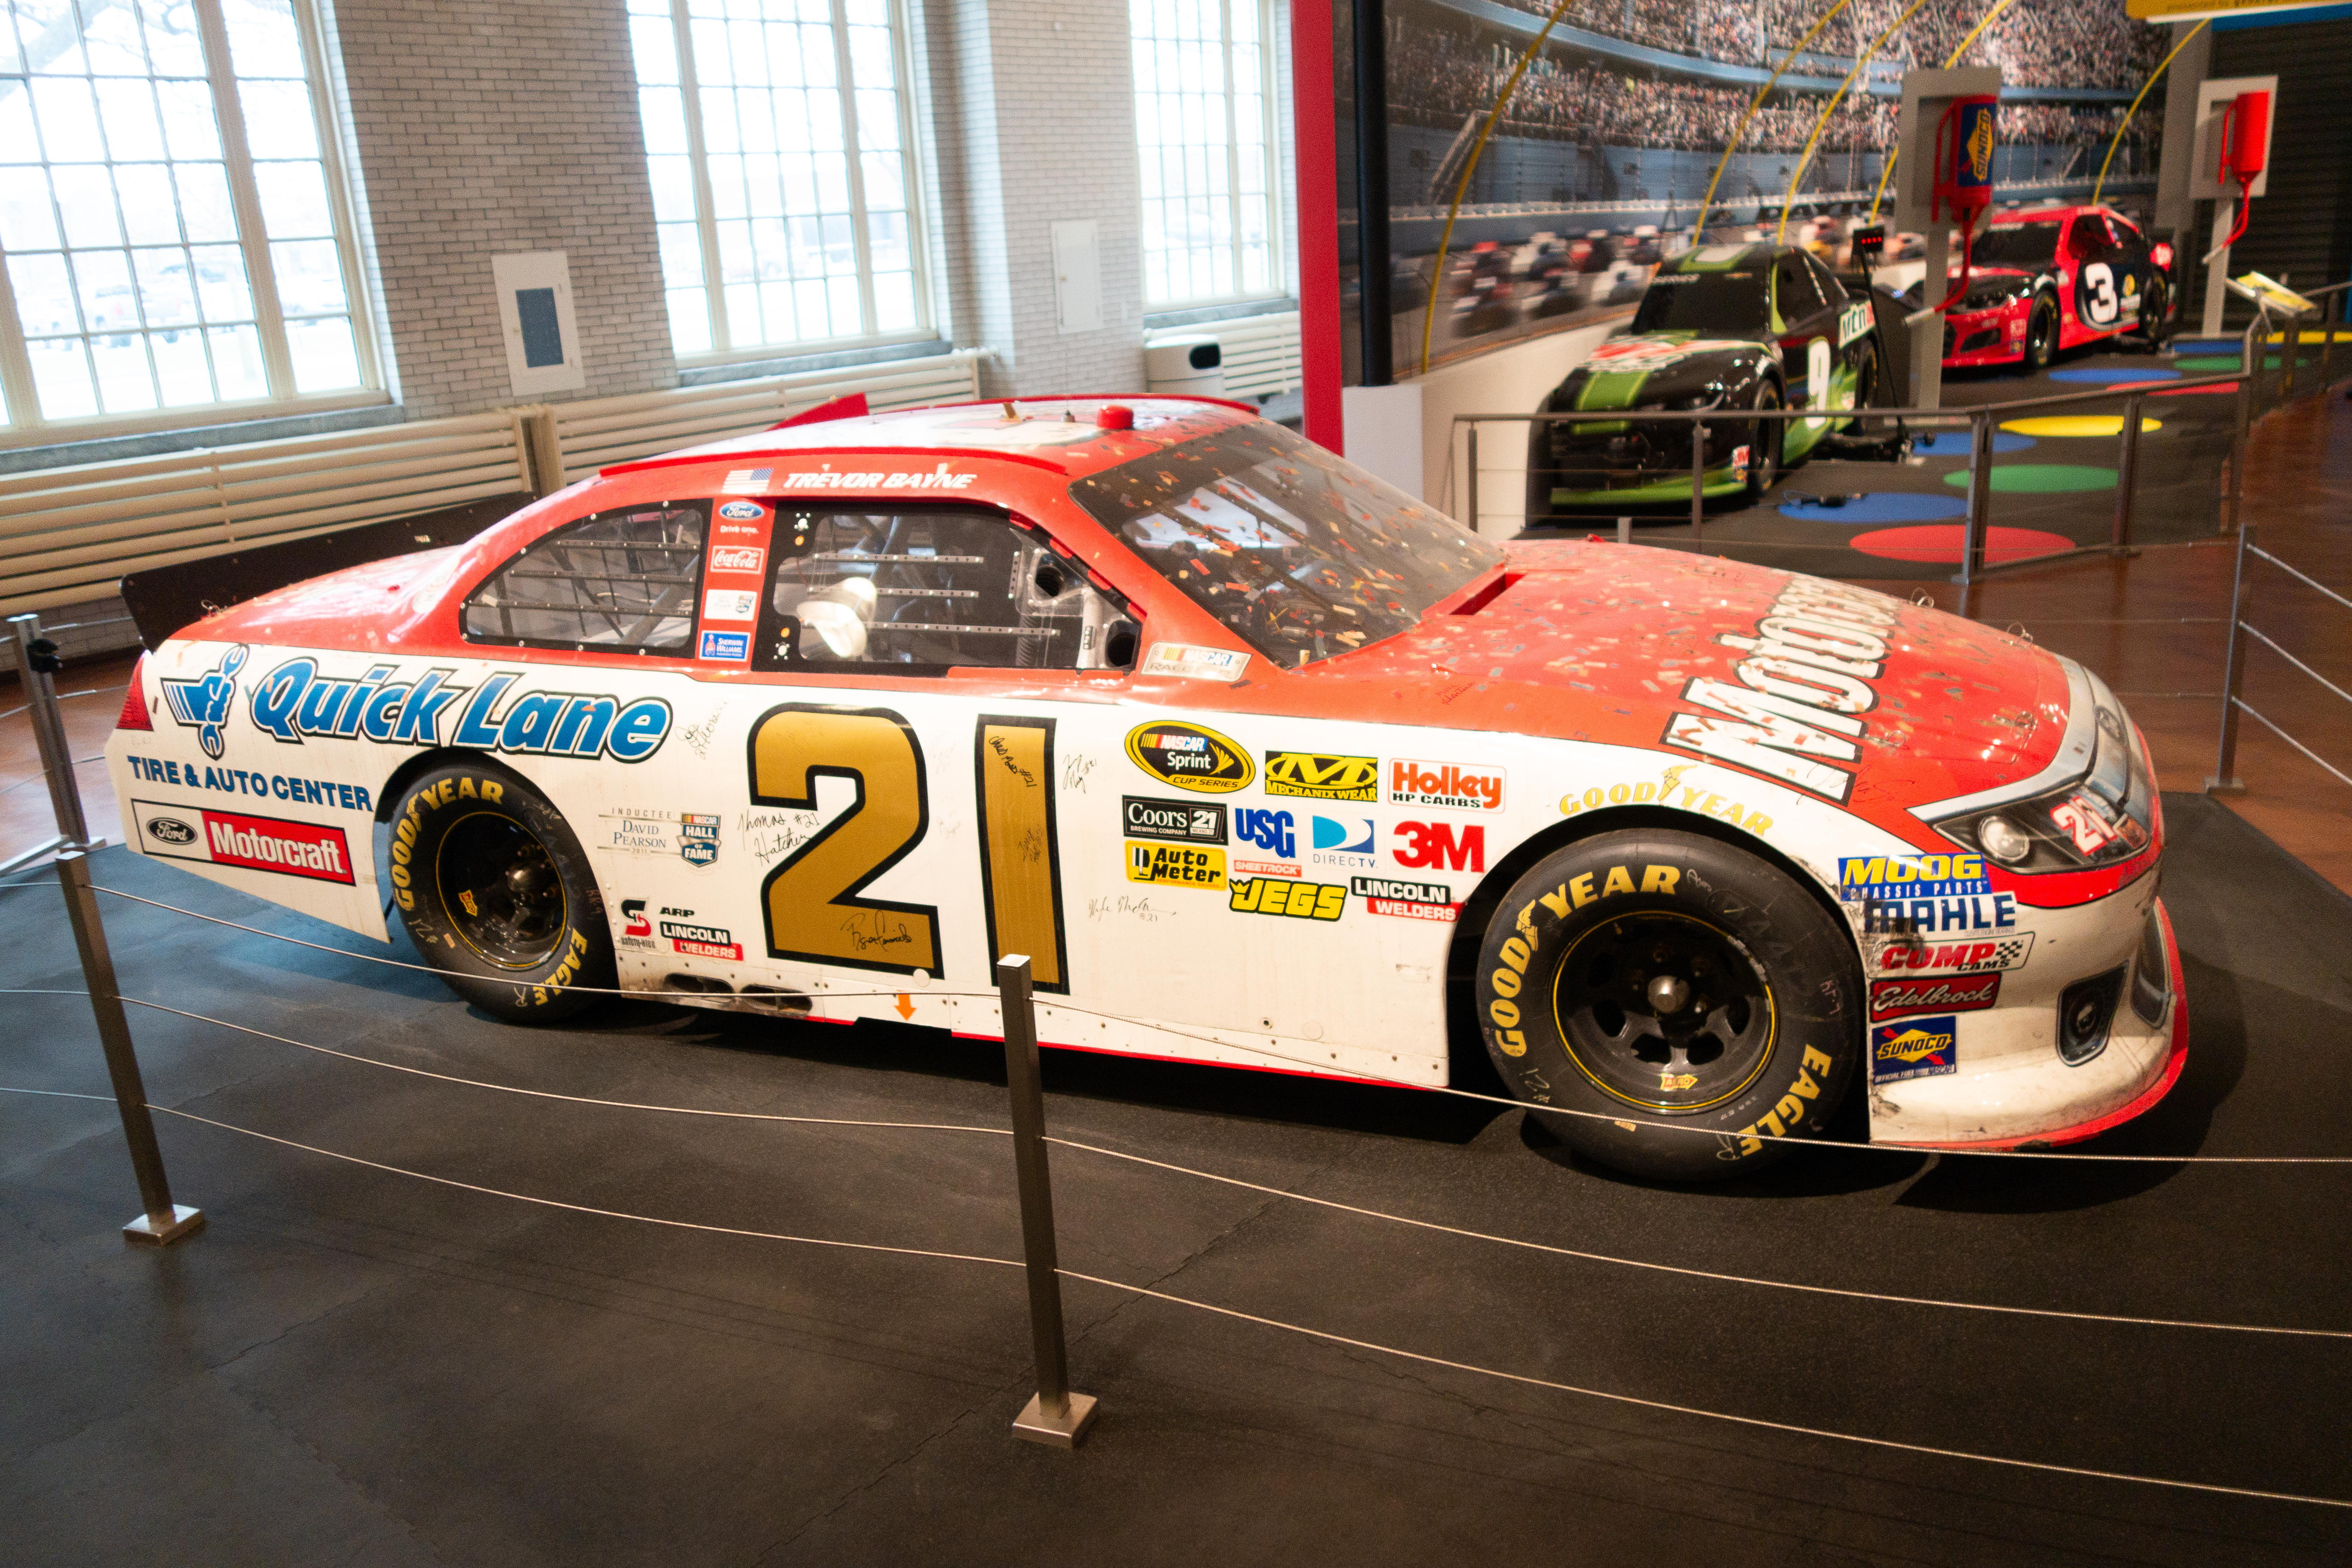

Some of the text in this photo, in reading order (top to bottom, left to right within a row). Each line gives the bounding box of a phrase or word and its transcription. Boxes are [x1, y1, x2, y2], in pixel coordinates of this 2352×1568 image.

[2085, 262, 2117, 322] 3
[1806, 339, 1830, 429] 9
[784, 473, 977, 489] TREVOR BAYNE
[1149, 662, 1192, 673] RACE
[1182, 649, 1229, 666] NASCAR
[1659, 574, 1902, 807] Motorc
[250, 656, 466, 747] Quick
[453, 670, 673, 764] Lane
[1161, 735, 1206, 751] NASCAR
[1167, 751, 1211, 770] Sprint
[127, 755, 374, 812] TIRE & AUTO CENTER
[1198, 779, 1239, 788] SERIES
[1266, 780, 1377, 802] MECHANIX WEAR
[1393, 762, 1502, 809] Holley
[1393, 793, 1481, 808] HP CARBS
[612, 807, 671, 819] INDUCTEE
[1128, 803, 1217, 829] Coors 21
[686, 826, 714, 838] HALL
[1130, 825, 1157, 833] BREWING
[1235, 808, 1296, 858] USG
[2050, 795, 2116, 857] 21
[209, 821, 345, 874] Motorcraft
[685, 848, 714, 860] FAME
[747, 701, 1070, 995] 21
[1154, 848, 1208, 866] Auto
[1393, 821, 1485, 873] 3M
[1235, 861, 1298, 875] SHEETROCK
[1313, 854, 1375, 868] DIRECTV
[1843, 854, 1981, 885] MOOG
[1150, 863, 1221, 882] Meter
[1230, 877, 1348, 922] JEGS
[1355, 879, 1447, 903] LINCOLN
[1850, 881, 1983, 900] CHASSIS PARTS
[659, 906, 695, 917] ARP
[1375, 900, 1457, 921] WELDERS
[662, 924, 728, 945] LINCOLN
[680, 941, 737, 959] WELDERS
[1880, 943, 1996, 970] COMP
[533, 928, 588, 1006] EAGLE
[1957, 959, 2011, 971] CAMS
[1873, 981, 1995, 1013] Edelbrock
[1879, 1036, 1949, 1059] SUNOCO
[1737, 1044, 1832, 1157] EAGLE
